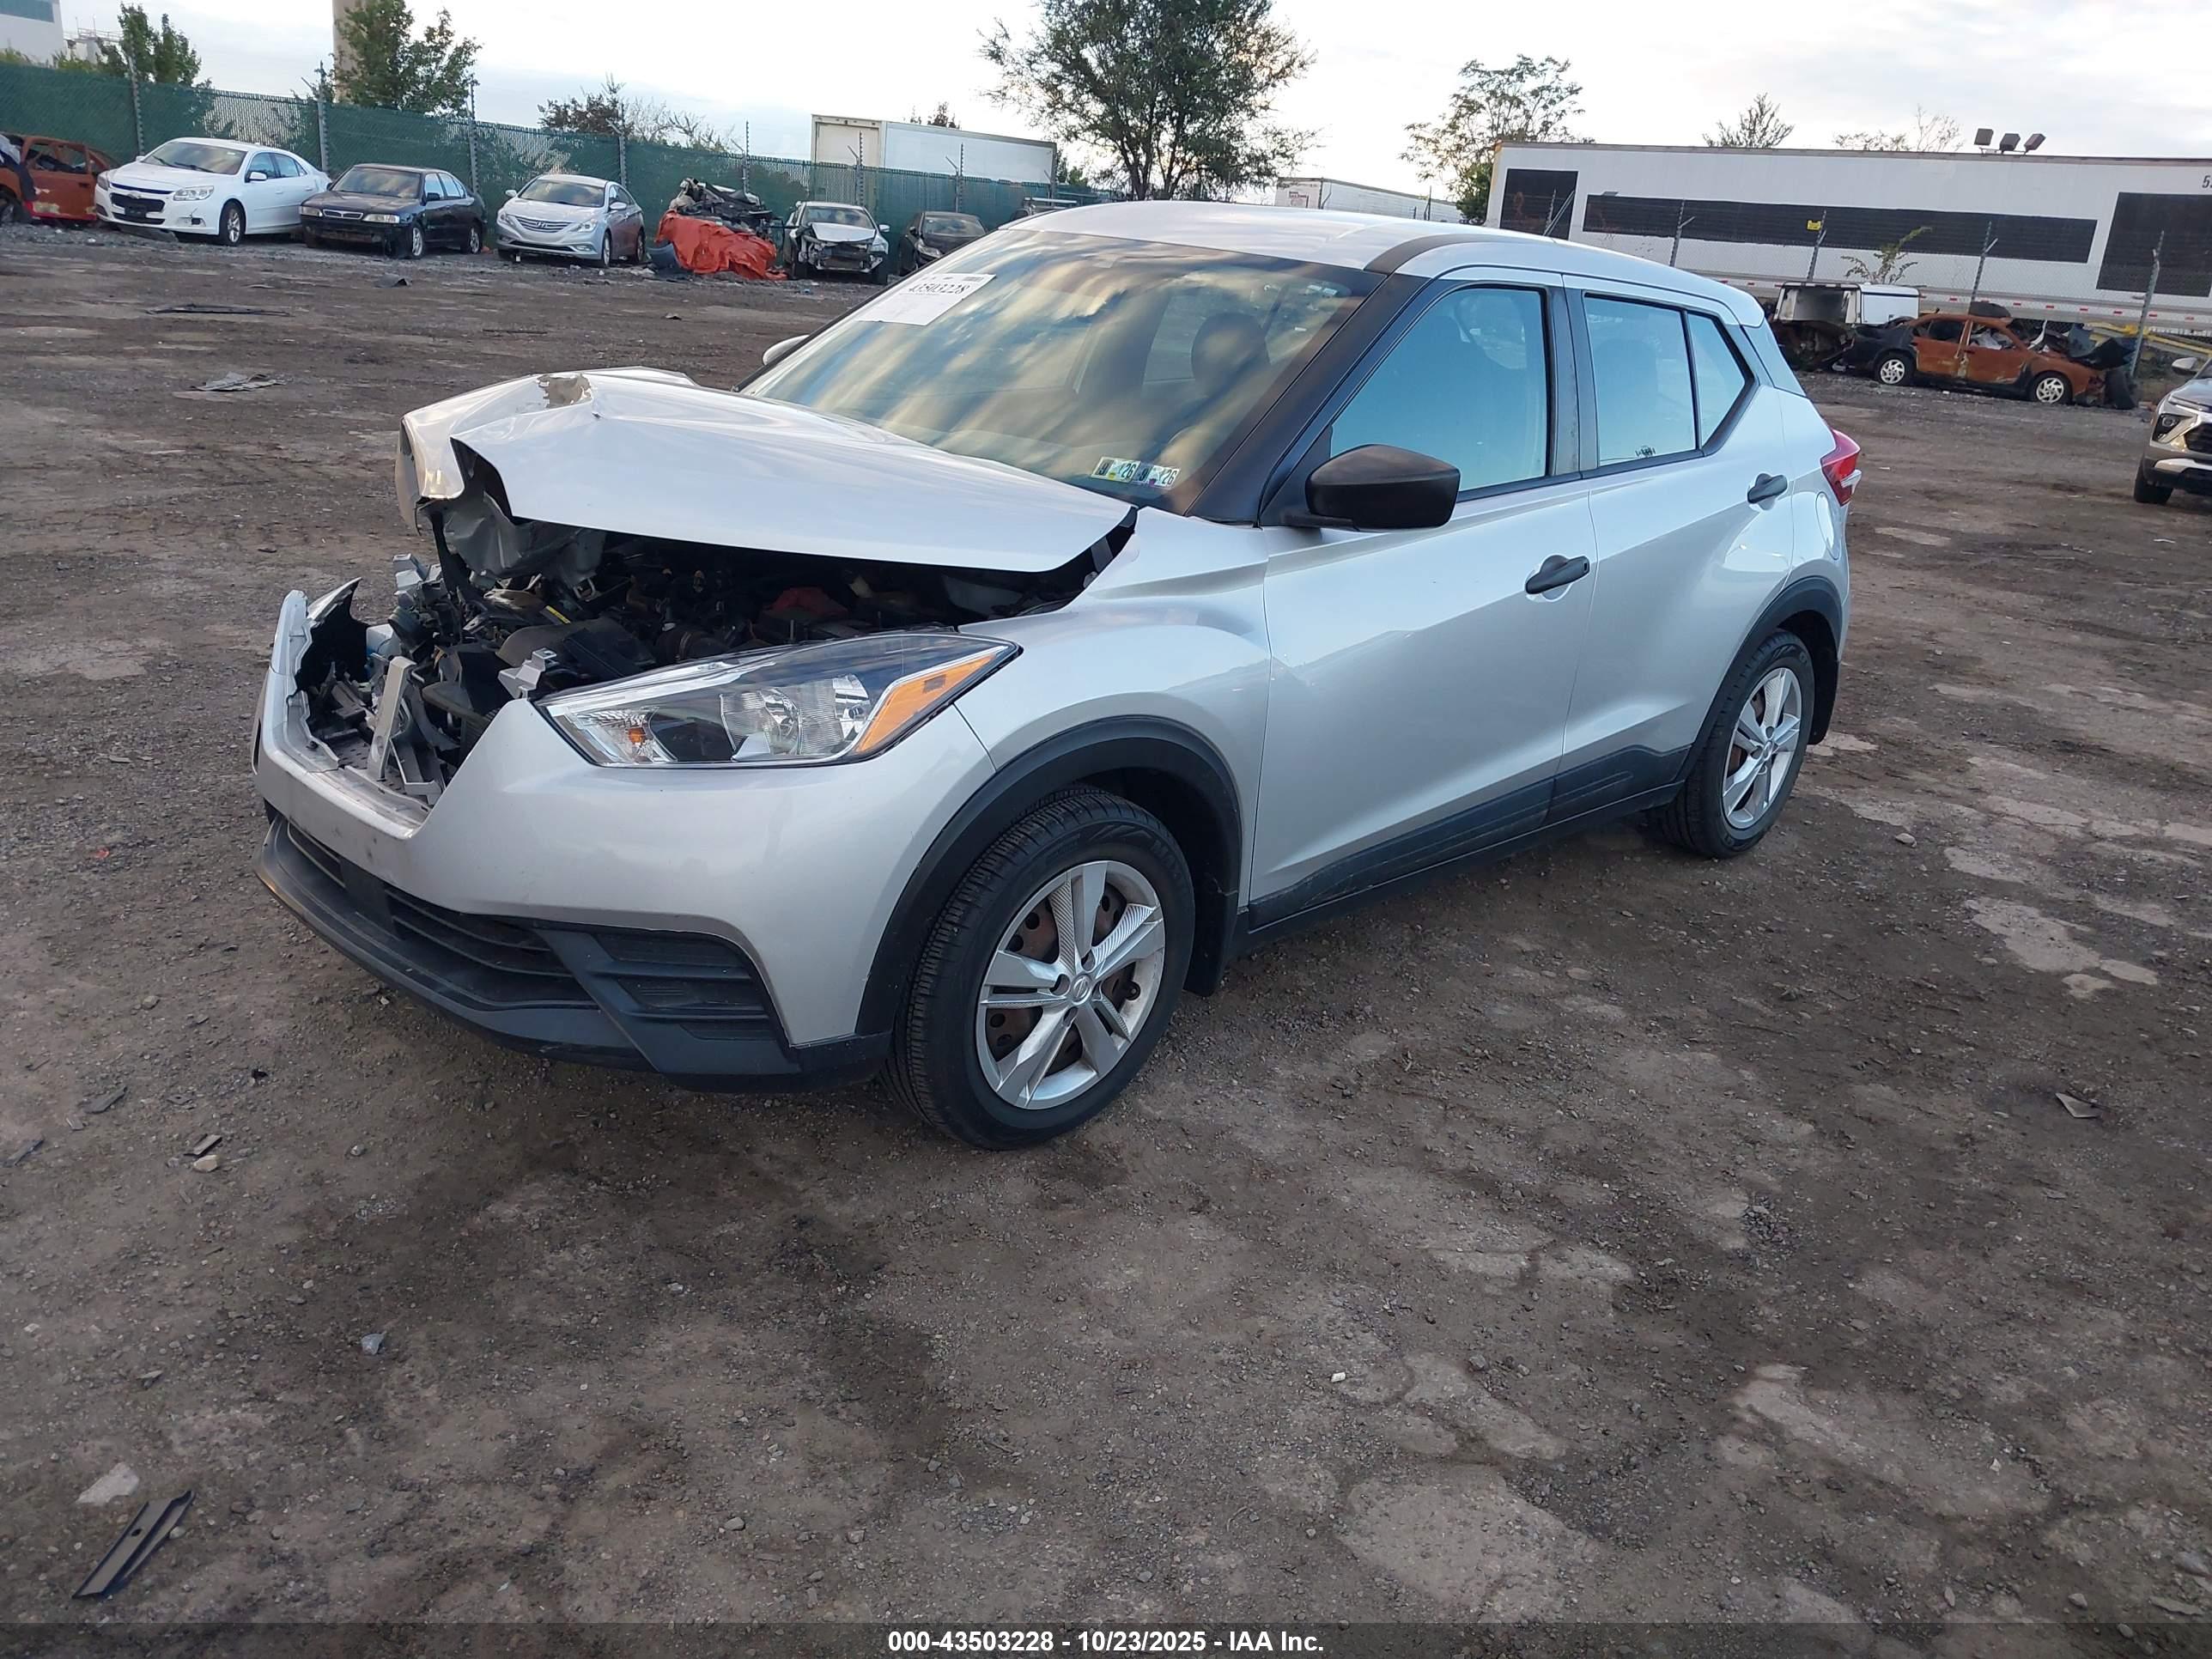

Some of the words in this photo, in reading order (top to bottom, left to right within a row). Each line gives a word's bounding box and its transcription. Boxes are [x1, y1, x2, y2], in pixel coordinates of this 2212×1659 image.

[2202, 174, 2212, 189] 5
[1121, 463, 1137, 479] 26
[1160, 469, 1177, 485] 26
